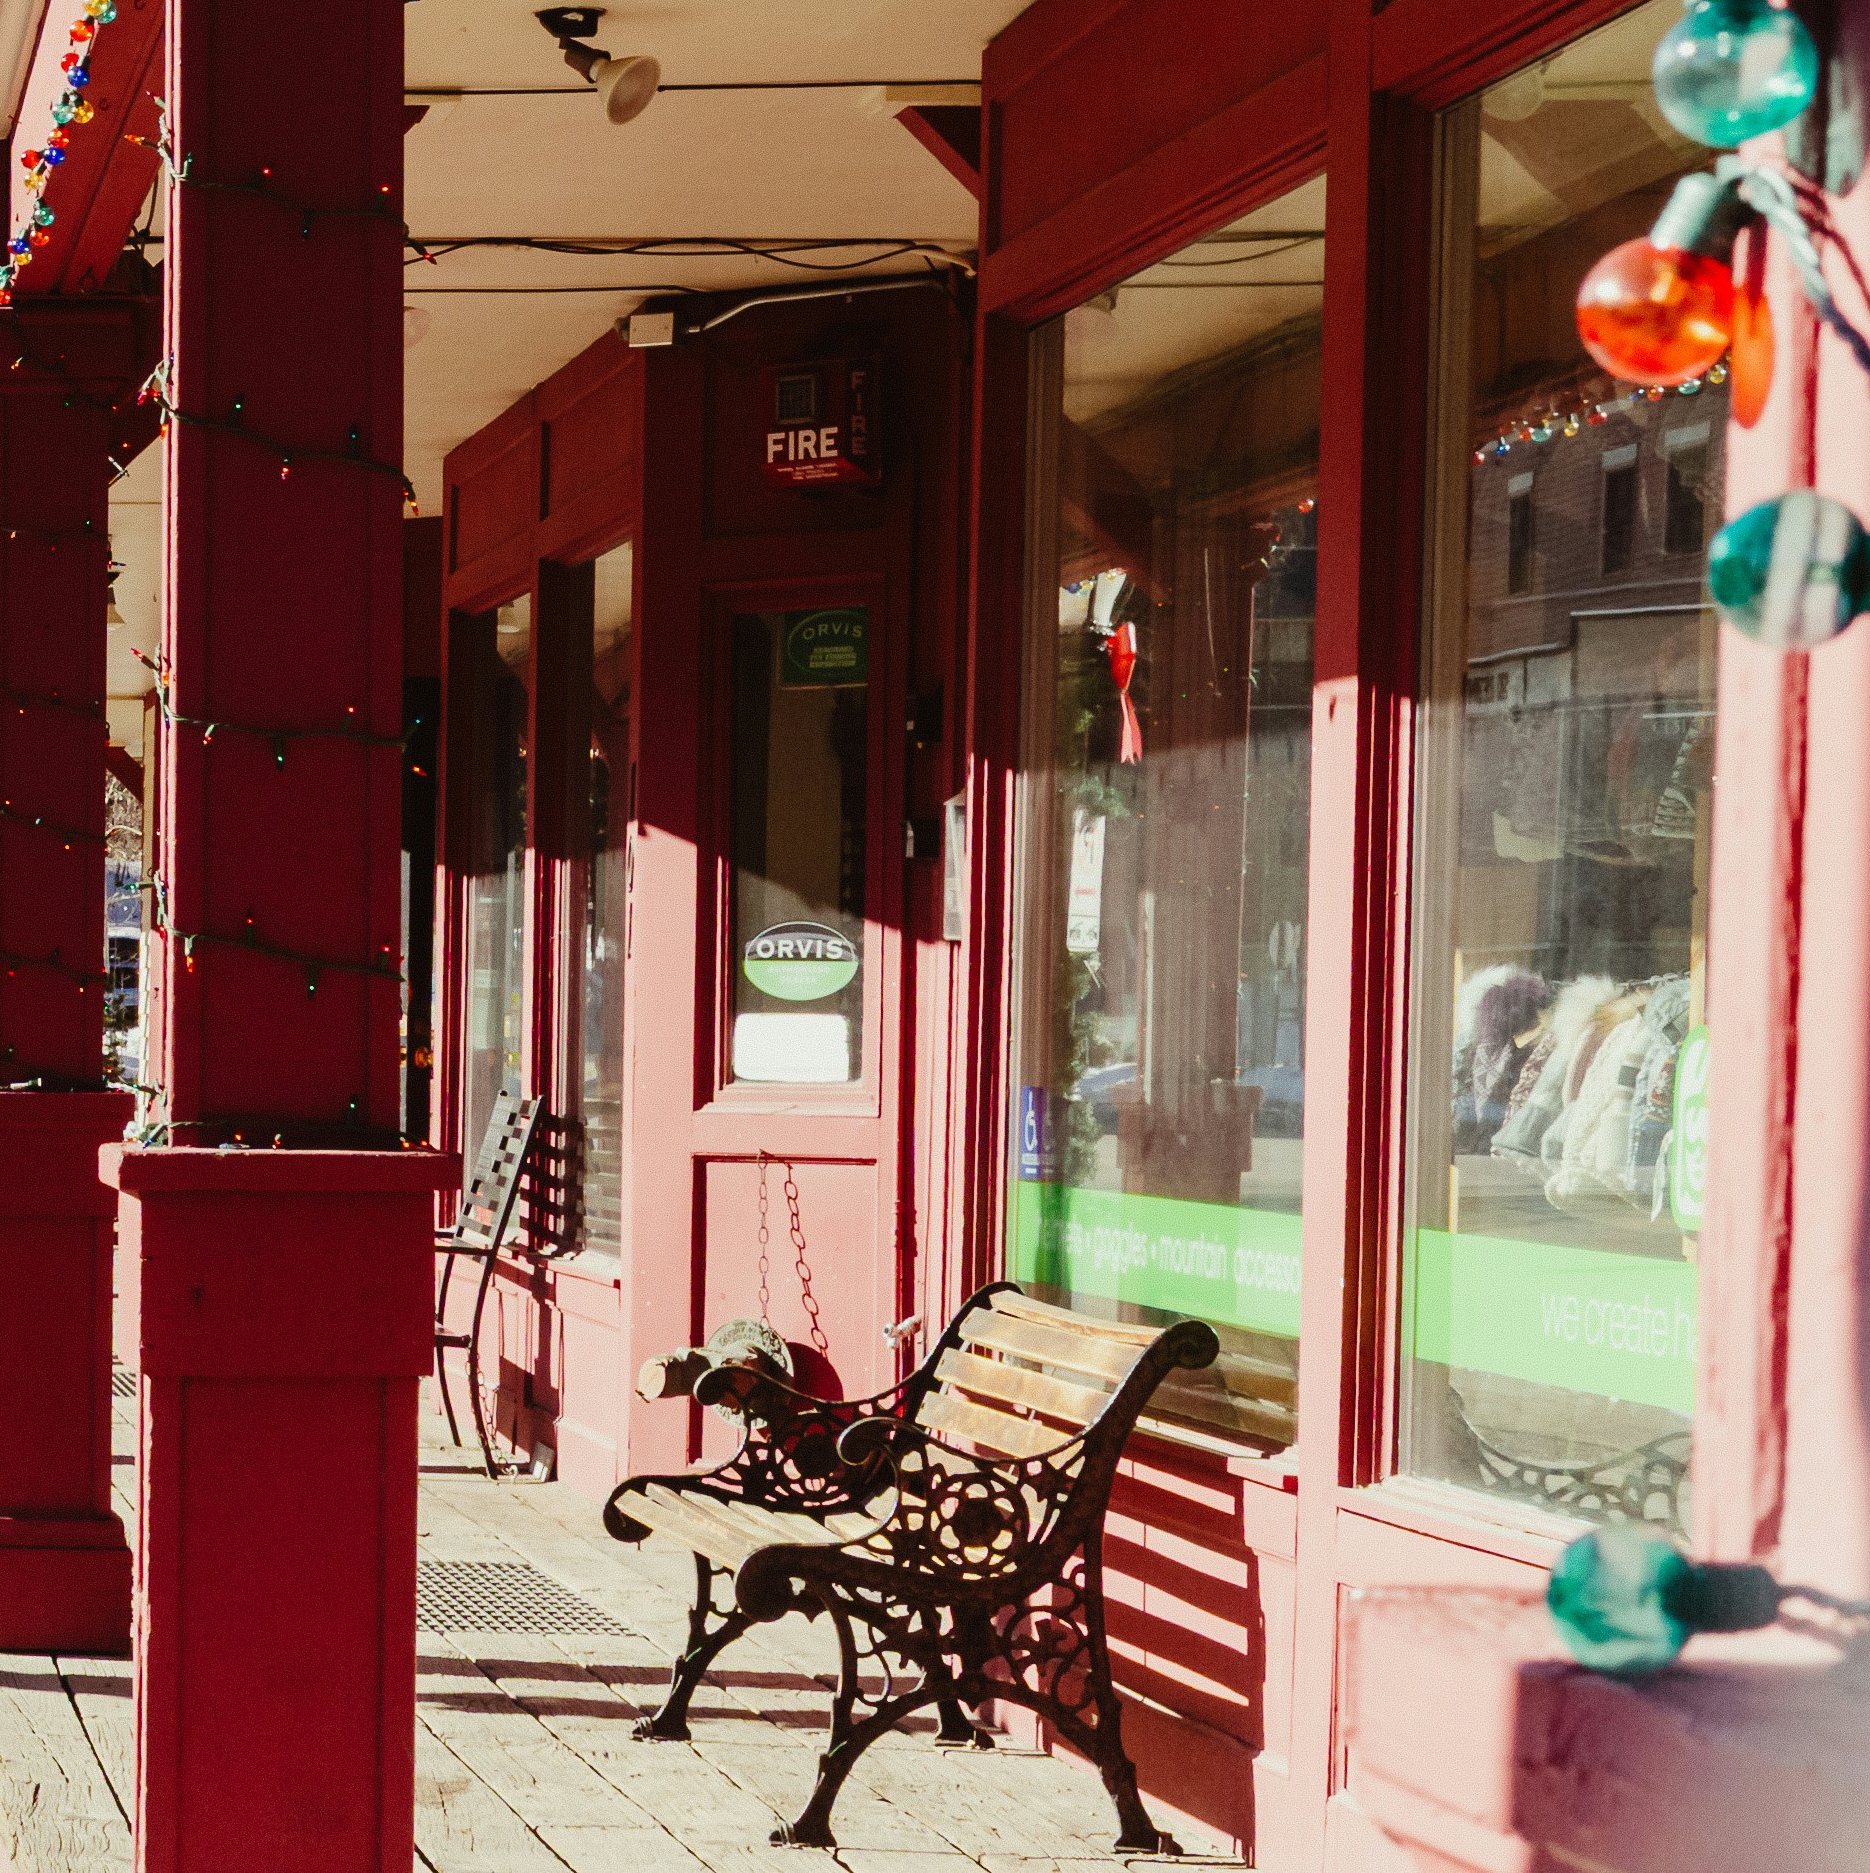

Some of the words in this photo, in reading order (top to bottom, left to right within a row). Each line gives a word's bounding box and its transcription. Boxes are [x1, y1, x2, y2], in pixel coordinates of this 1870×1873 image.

[851, 371, 867, 456] FIRE
[767, 426, 839, 464] FIRE
[802, 622, 862, 641] ORVIS
[755, 939, 844, 960] ORVIS
[1160, 1231, 1230, 1282] mountain
[1541, 1291, 1581, 1343] we
[1584, 1293, 1669, 1357] create
